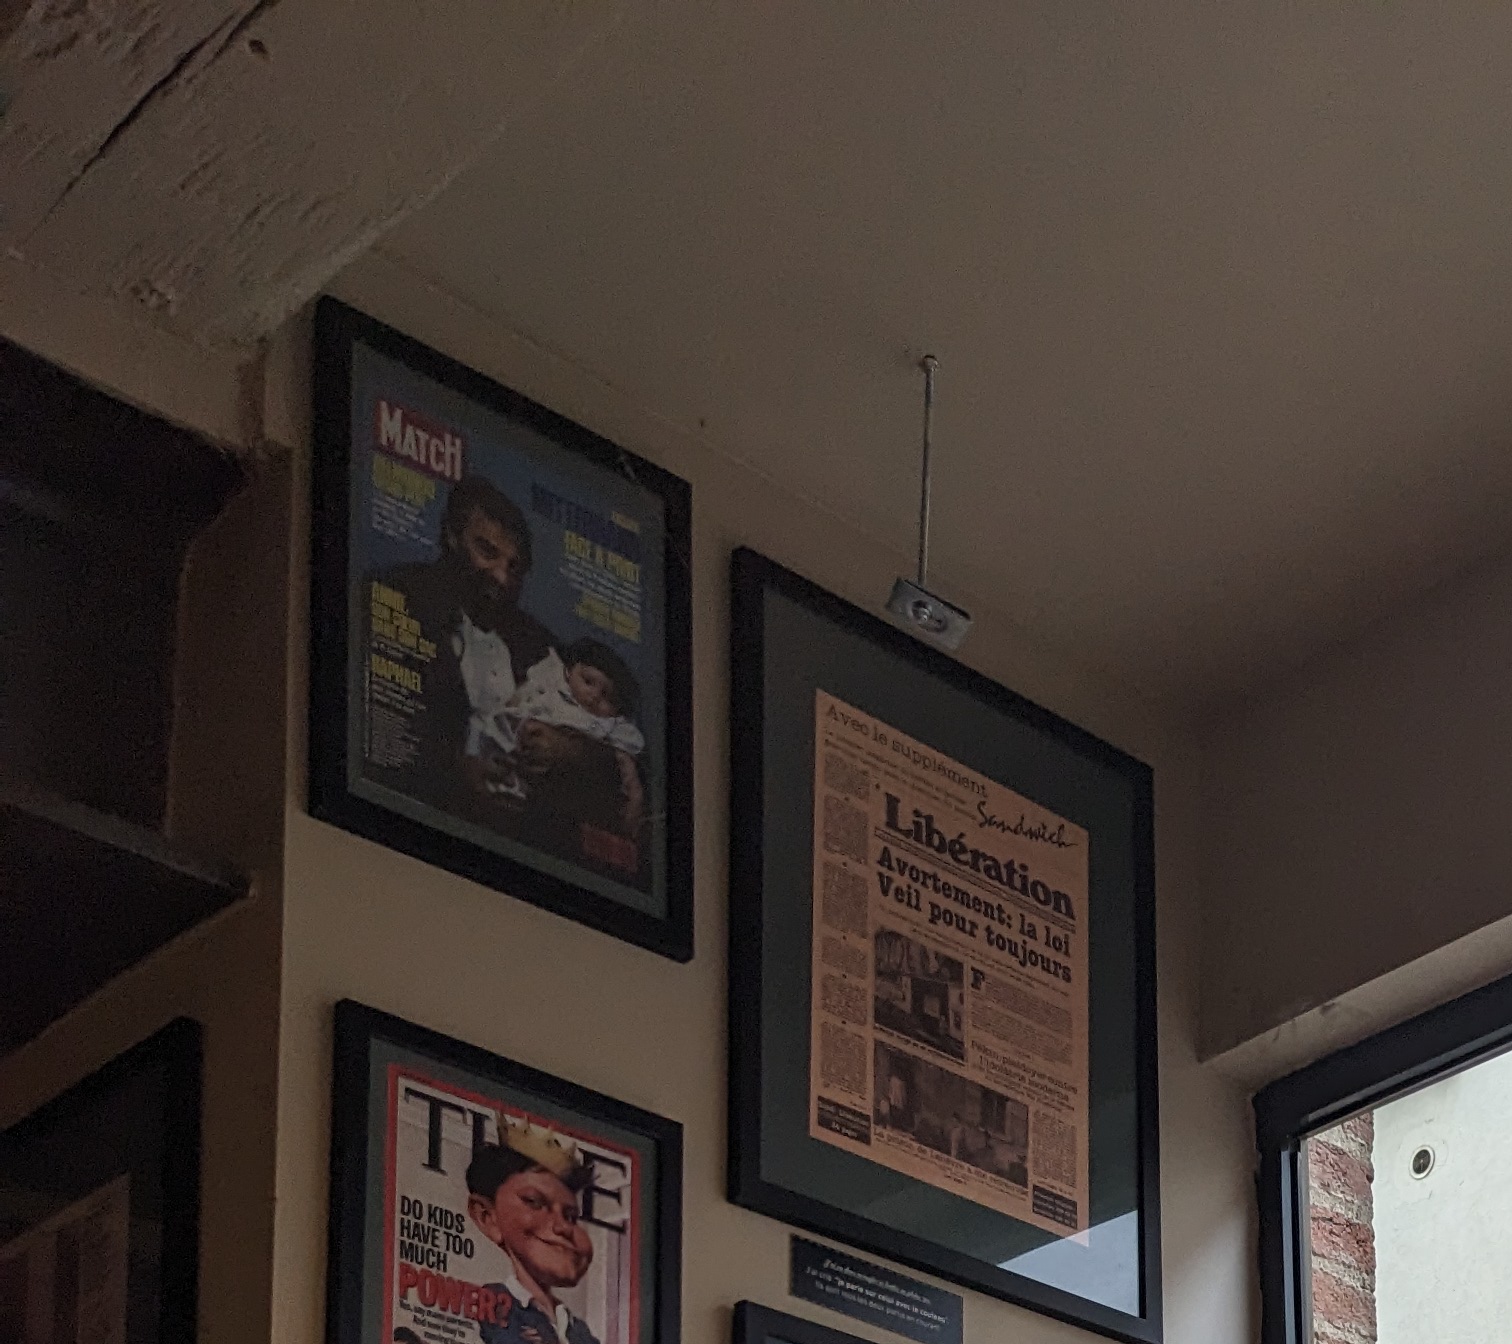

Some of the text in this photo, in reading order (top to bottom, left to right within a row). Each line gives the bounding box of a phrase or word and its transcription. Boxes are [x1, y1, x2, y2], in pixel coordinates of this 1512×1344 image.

[378, 400, 463, 481] MATCH
[827, 704, 869, 737] Avec
[872, 723, 887, 746] le
[884, 792, 1077, 921] Libération
[876, 871, 922, 913] Veil
[929, 901, 979, 939] pour
[985, 925, 1073, 984] toujours
[877, 846, 1072, 958] Avortement: la loi
[401, 1196, 465, 1234] DO KIDS
[401, 1218, 475, 1259] HAVE TOO
[400, 1240, 448, 1272] MUCH
[399, 1263, 513, 1328] POWER?
